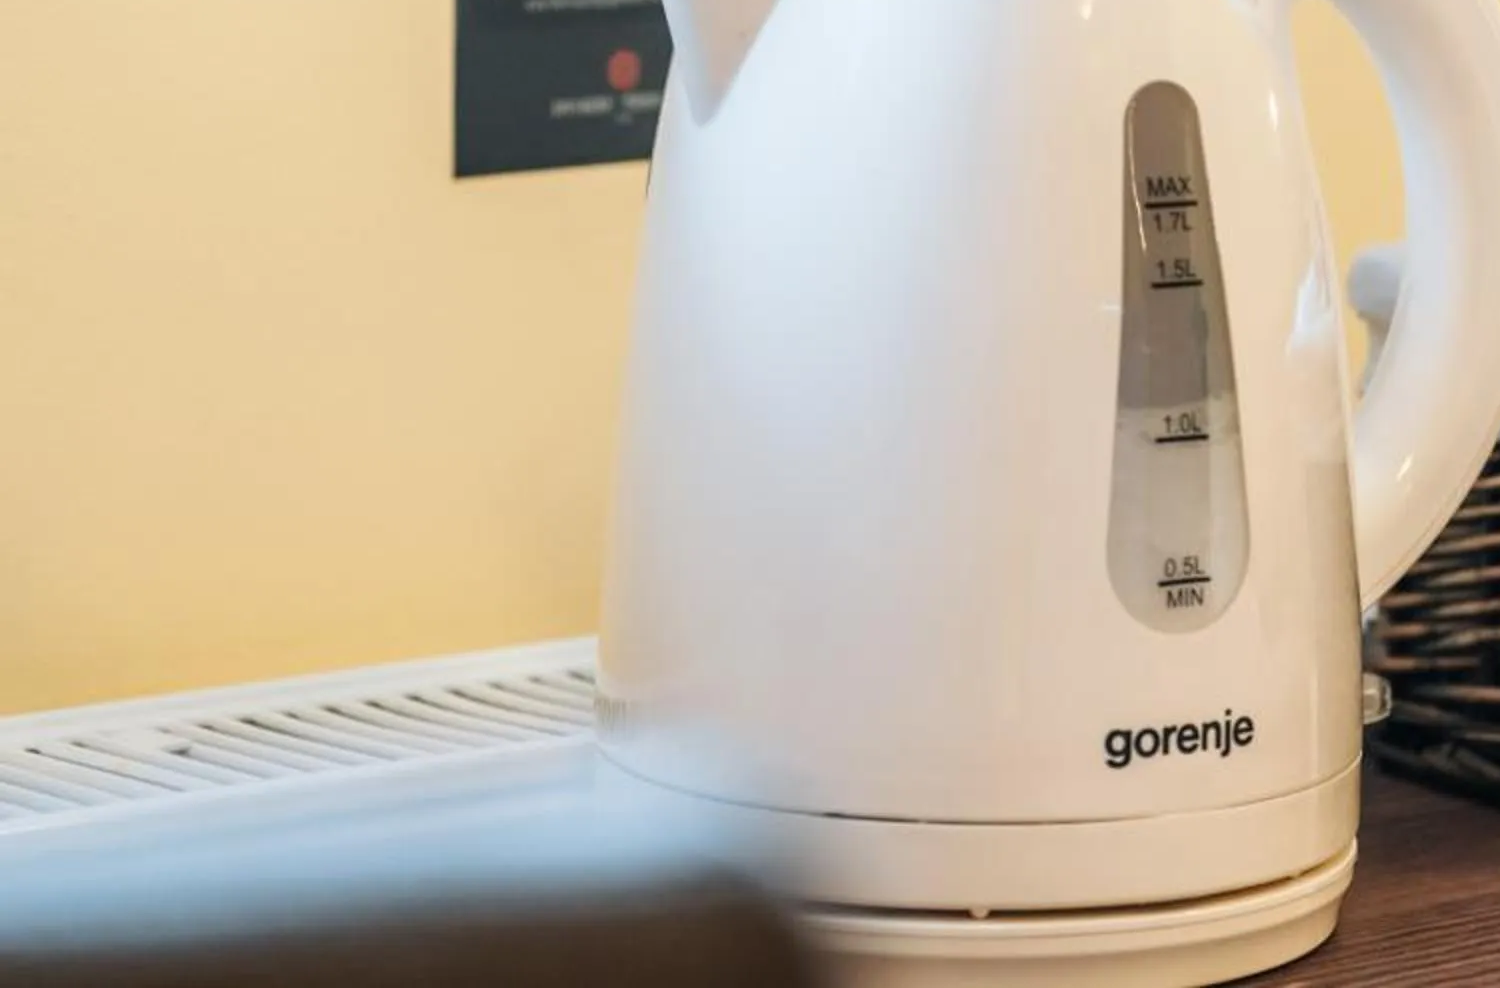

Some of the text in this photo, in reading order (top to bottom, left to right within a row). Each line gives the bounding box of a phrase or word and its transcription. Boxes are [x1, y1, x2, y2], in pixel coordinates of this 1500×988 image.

[1146, 176, 1193, 198] MAX
[1153, 211, 1193, 233] 1.7L
[1157, 258, 1198, 280] 1.5L
[1163, 413, 1202, 434] 1.0L
[1164, 556, 1206, 578] 0.5L
[1166, 587, 1205, 609] MIN
[1104, 708, 1255, 769] gorenje
